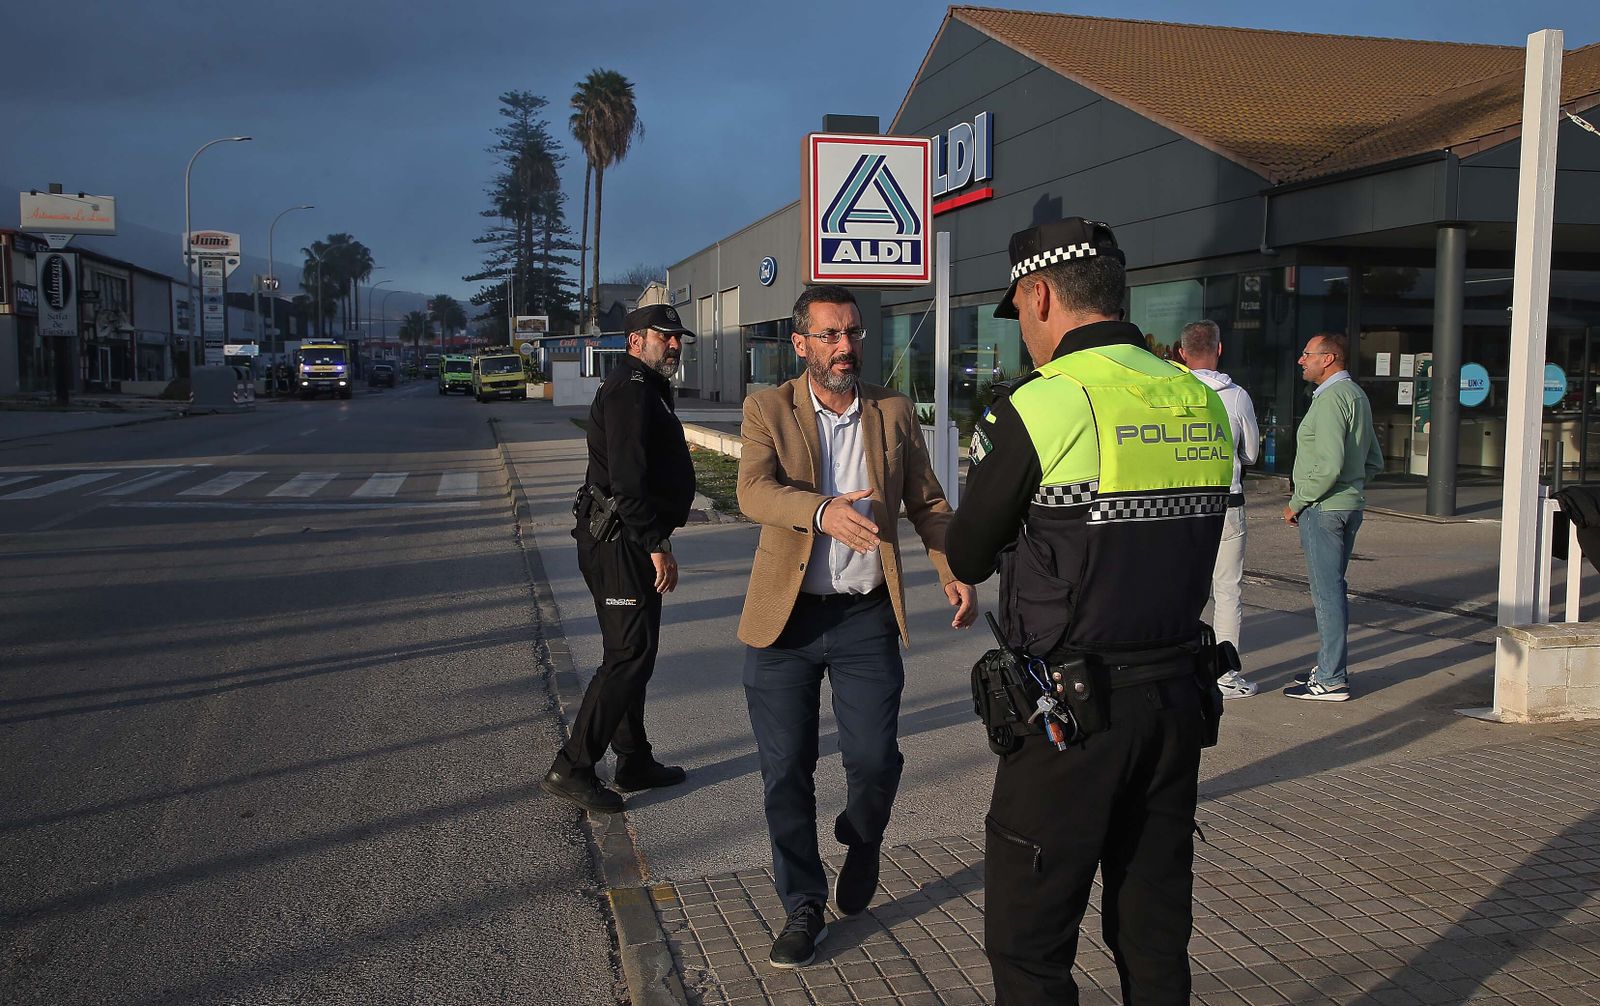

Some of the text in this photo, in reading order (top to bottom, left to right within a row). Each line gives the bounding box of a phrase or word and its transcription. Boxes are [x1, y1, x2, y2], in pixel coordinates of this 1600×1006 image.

[932, 111, 992, 197] LDI
[831, 240, 912, 263] ALDI
[584, 338, 601, 347] Bar
[1115, 422, 1228, 446] POLICIA
[1174, 446, 1230, 462] LOCAL
